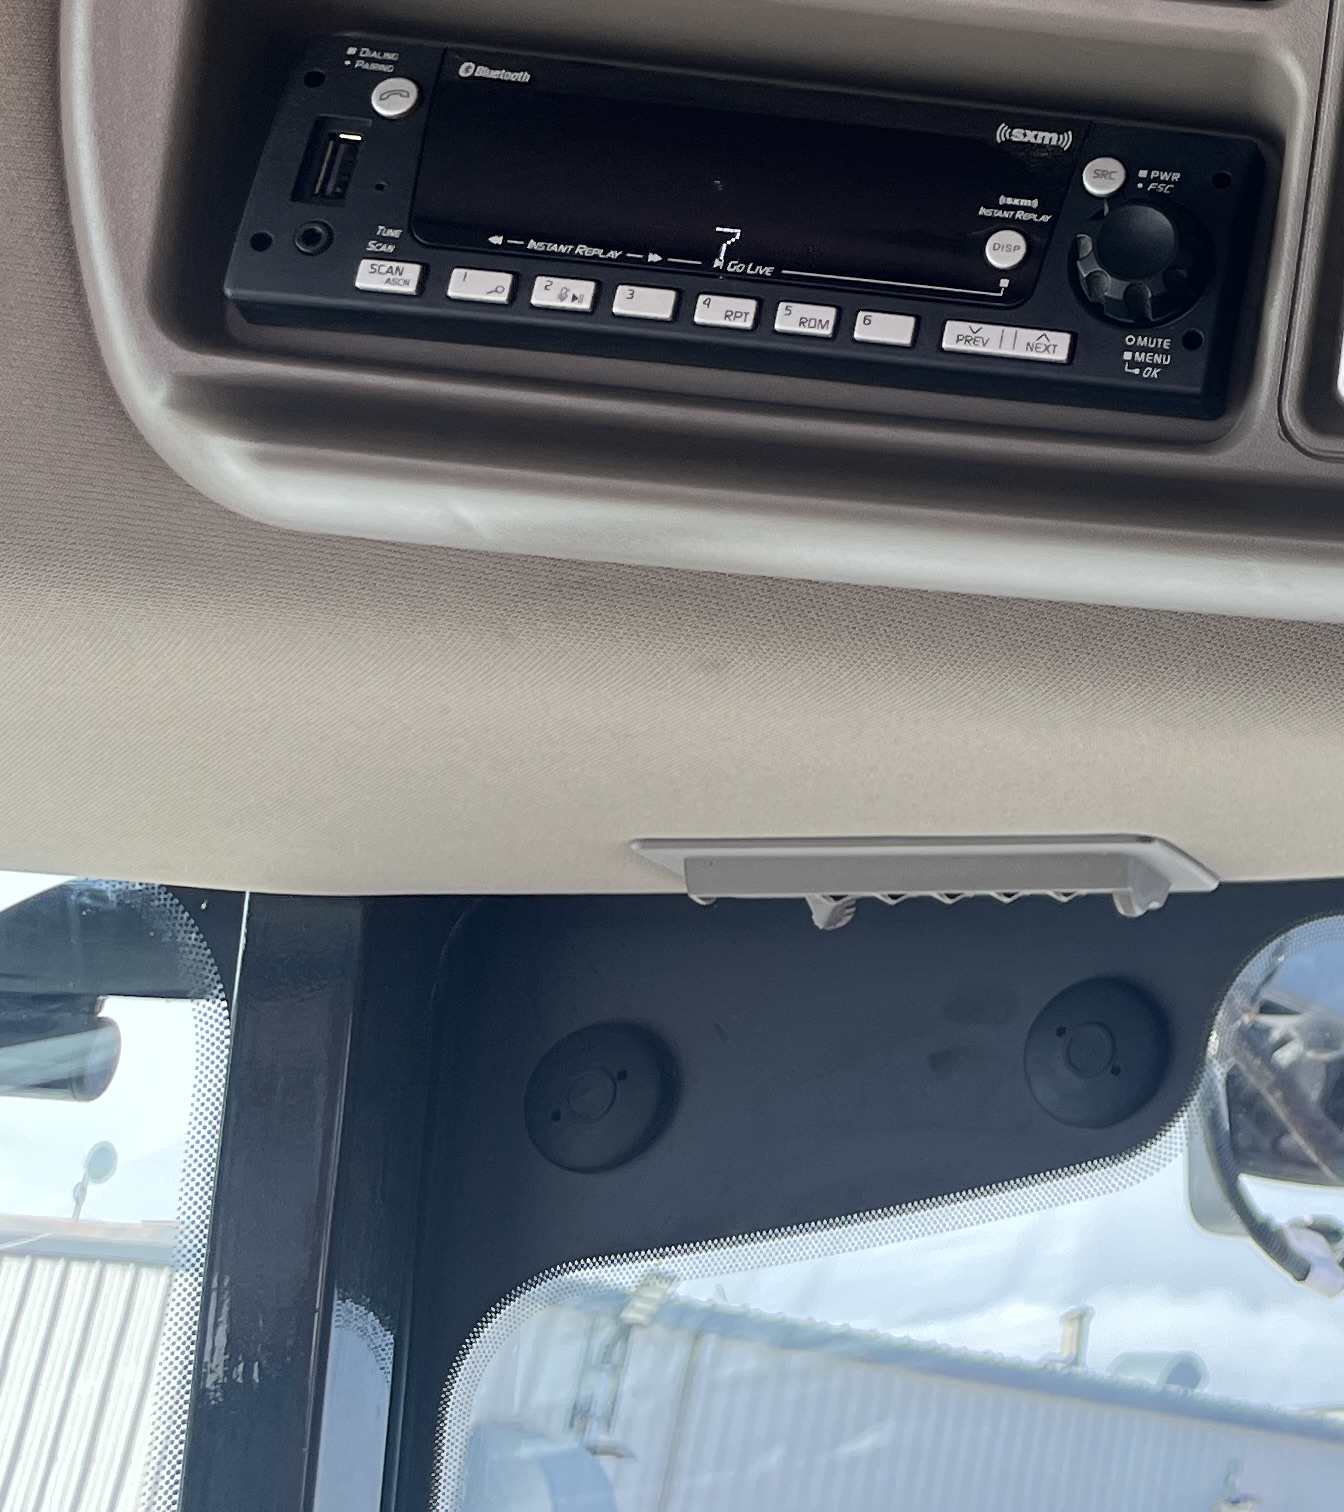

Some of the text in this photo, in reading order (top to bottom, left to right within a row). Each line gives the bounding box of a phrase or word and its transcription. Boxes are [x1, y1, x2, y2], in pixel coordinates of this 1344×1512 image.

[475, 65, 531, 83] Bluetooth
[1010, 128, 1060, 146] sxm
[1092, 168, 1117, 181] SRC
[1150, 170, 1181, 182] PWR
[1147, 183, 1175, 194] FSC
[992, 242, 1021, 253] DISP
[368, 263, 405, 276] SCAN
[543, 280, 554, 292] 2
[625, 289, 635, 300] 3
[702, 297, 712, 309] 4
[723, 309, 750, 323] RPT
[783, 305, 793, 316] 5
[798, 316, 830, 331] RDM
[862, 314, 872, 326] 6
[955, 334, 990, 348] PREV
[1136, 337, 1172, 350] MUTE
[1025, 341, 1058, 355] NEXT
[1134, 352, 1171, 365] MENU
[1142, 367, 1161, 379] OK
